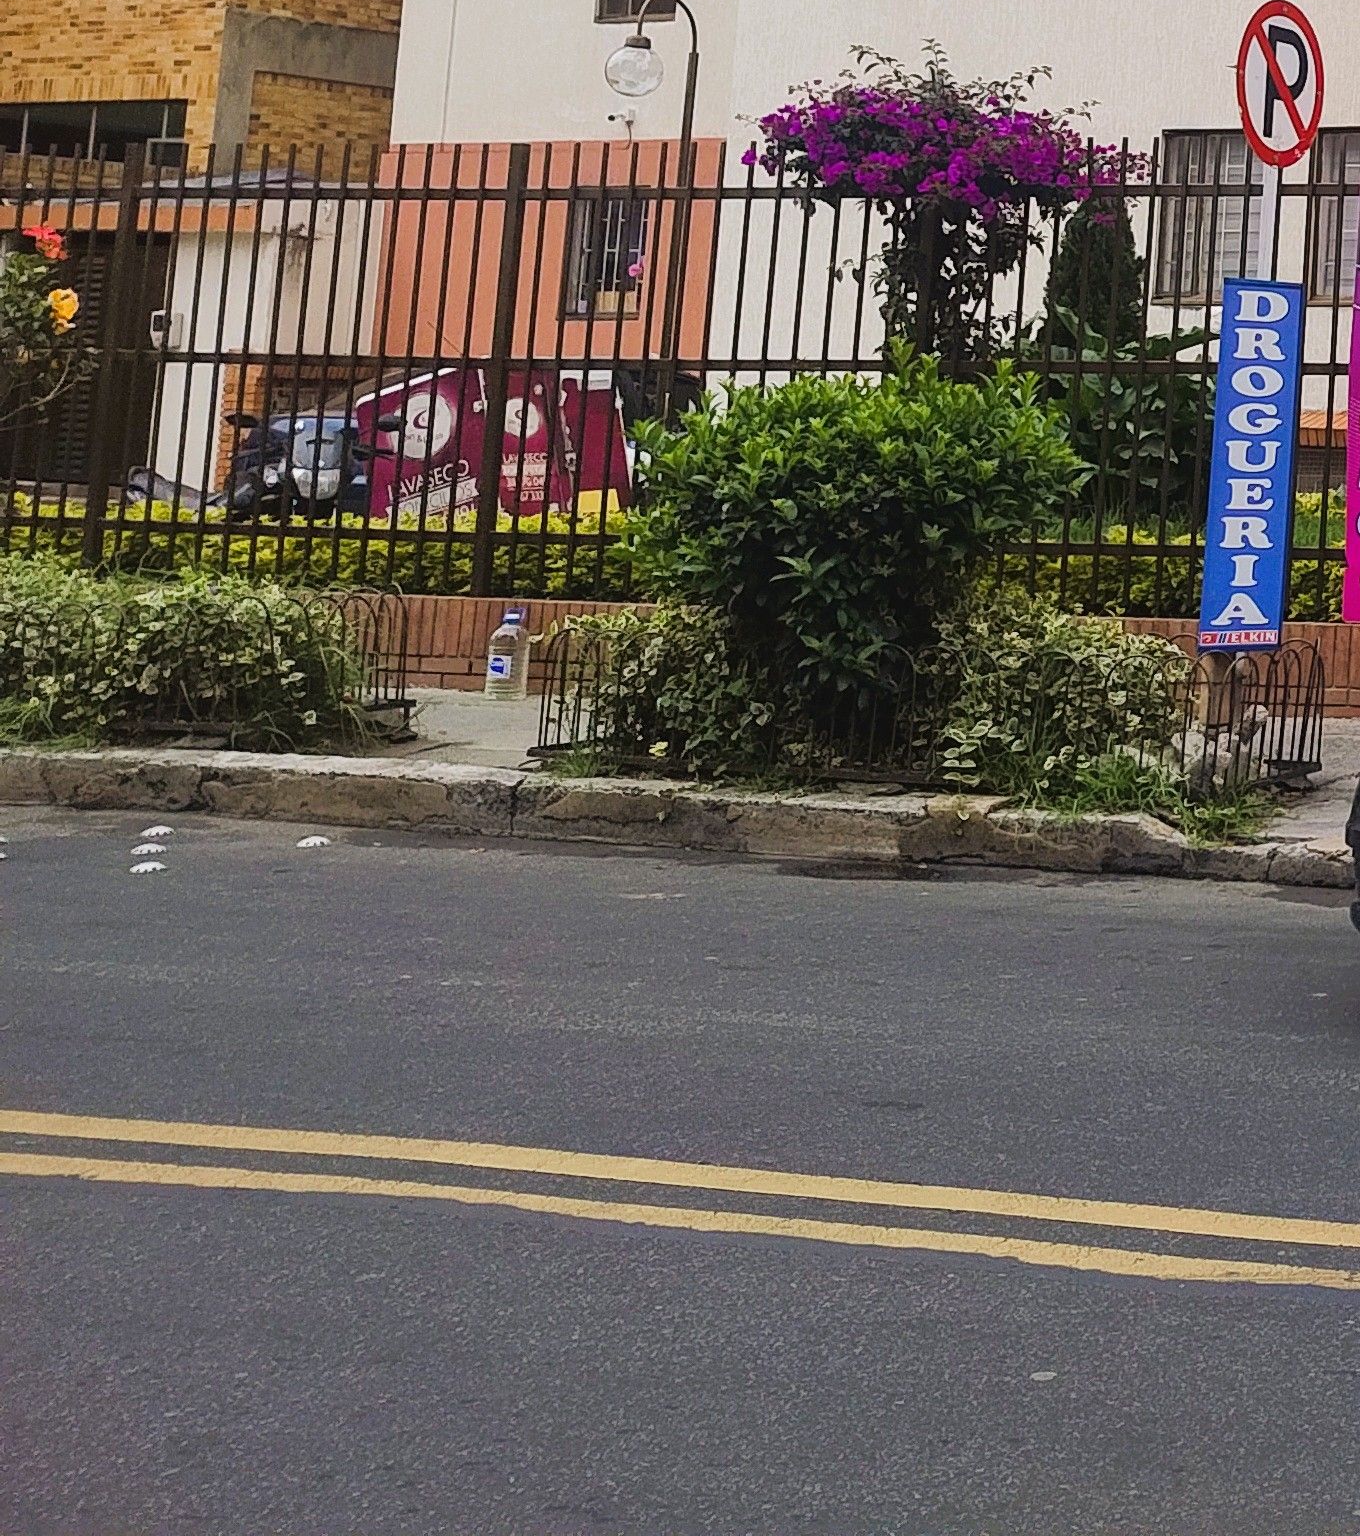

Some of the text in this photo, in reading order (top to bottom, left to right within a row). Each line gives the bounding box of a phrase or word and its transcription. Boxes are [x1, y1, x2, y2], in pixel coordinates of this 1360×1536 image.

[1263, 24, 1308, 138] P
[1210, 289, 1289, 626] DROGUERIA
[1231, 631, 1276, 643] ELKIN
